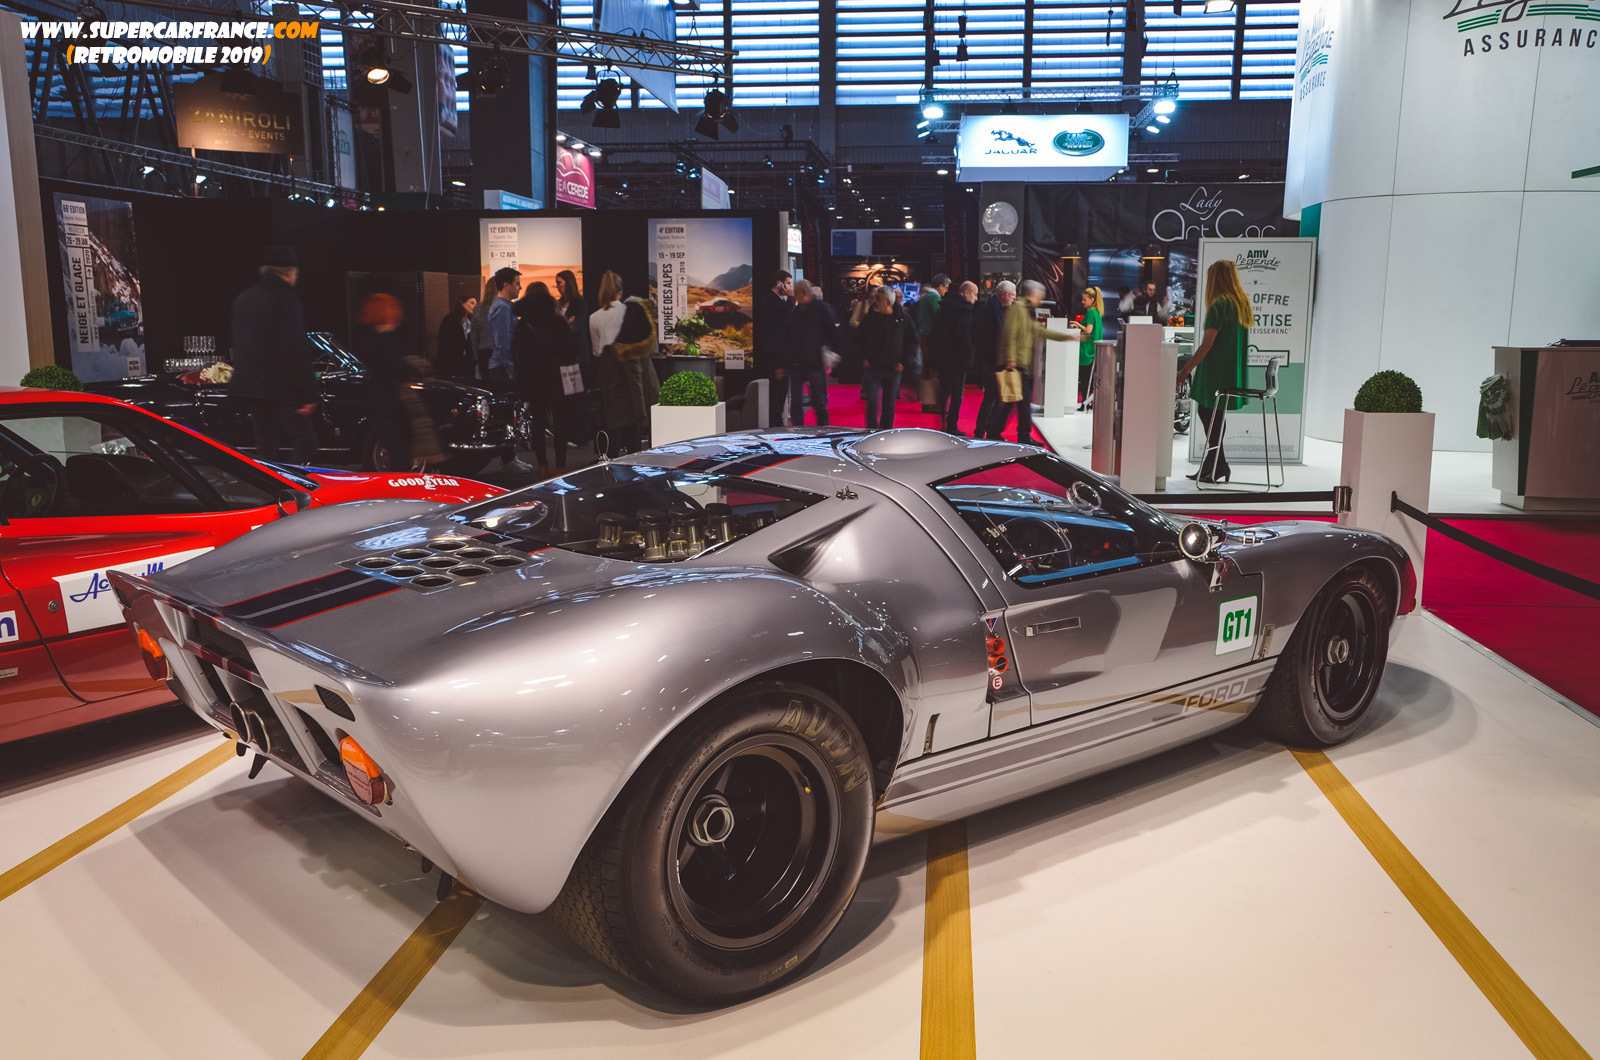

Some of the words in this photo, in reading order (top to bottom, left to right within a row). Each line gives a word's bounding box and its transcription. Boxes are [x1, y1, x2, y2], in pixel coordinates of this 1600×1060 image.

[1463, 28, 1598, 57] ASSURANC
[1300, 71, 1326, 102] ASSURANCE
[190, 106, 291, 130] ZANIROLI
[249, 129, 286, 141] EVENTS
[70, 205, 86, 214] EDITION
[1180, 186, 1222, 220] Lady
[72, 257, 84, 292] GLACE
[663, 263, 672, 288] ALPES
[76, 296, 85, 309] ET
[663, 289, 673, 304] DES
[1253, 293, 1290, 306] OFFRE
[78, 312, 89, 344] NEIGE
[661, 306, 673, 340] TROPHÉE
[1254, 314, 1292, 326] RTISE
[1223, 608, 1252, 643] GT1
[1184, 681, 1245, 712] FORD
[773, 700, 868, 792] AVON
